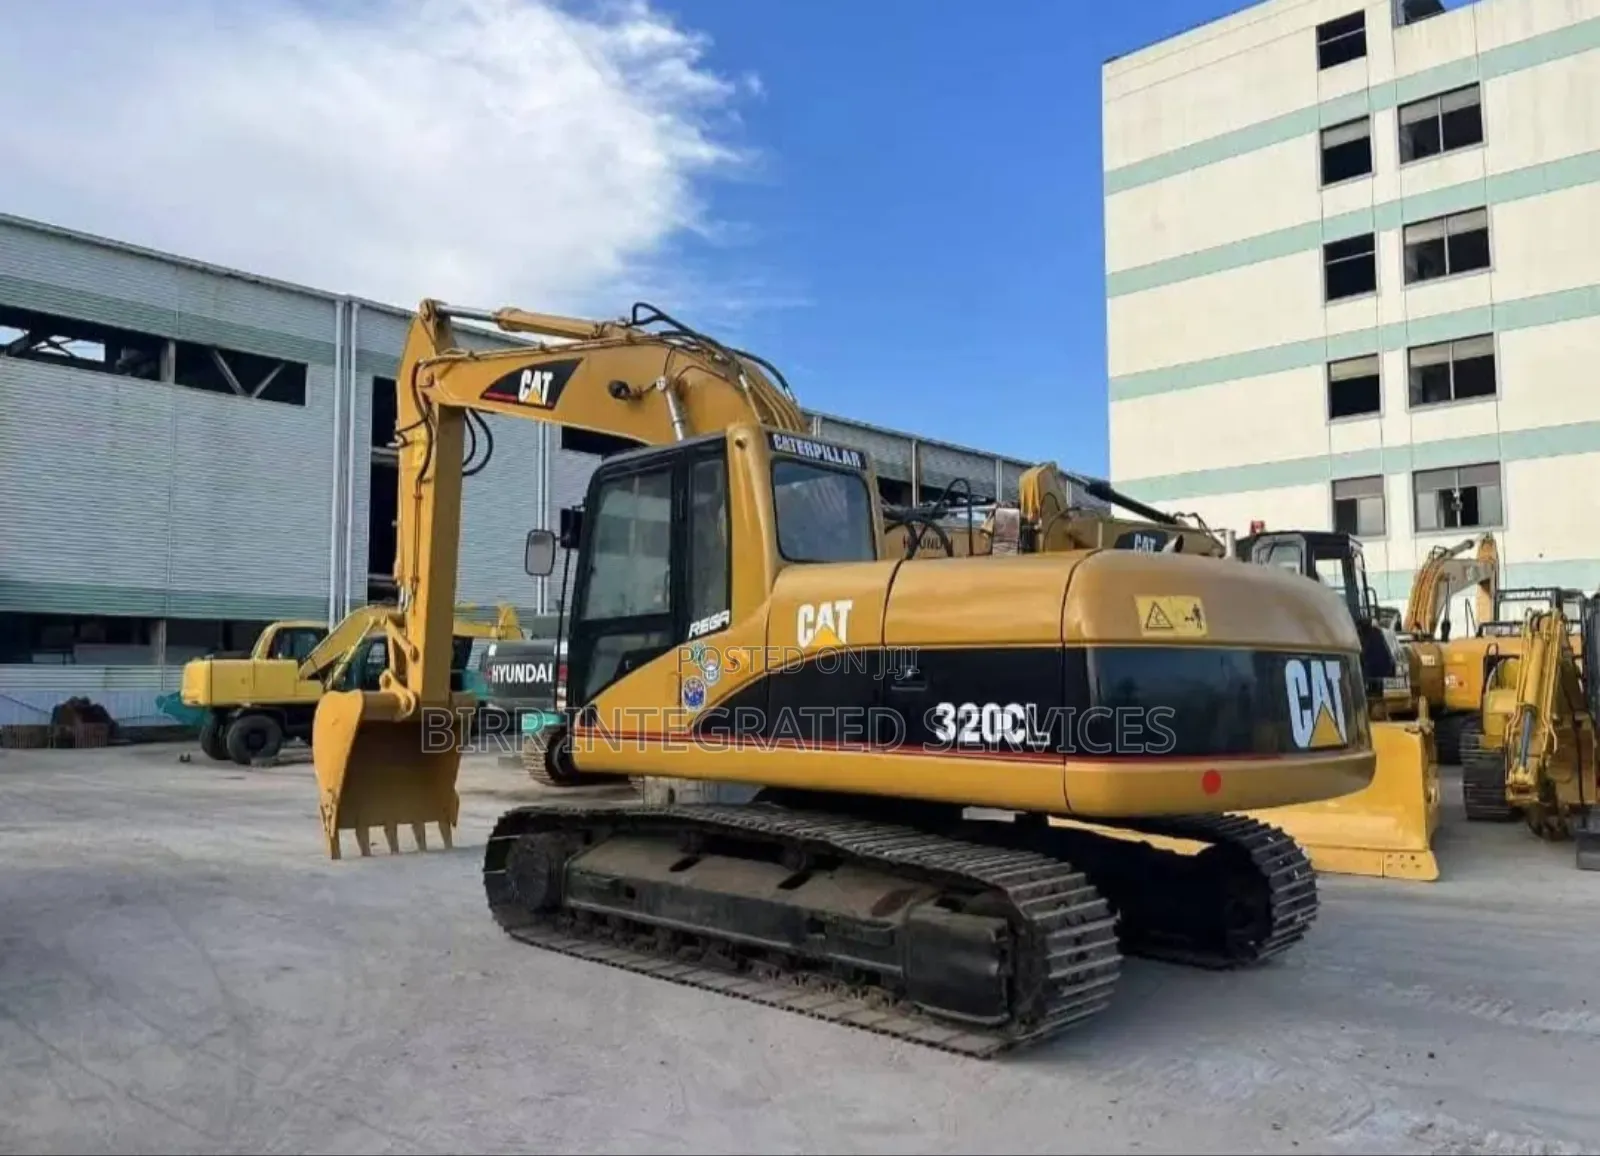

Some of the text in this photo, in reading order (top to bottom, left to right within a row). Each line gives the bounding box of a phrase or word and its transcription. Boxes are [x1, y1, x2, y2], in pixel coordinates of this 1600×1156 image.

[518, 369, 553, 406] CAT
[773, 433, 861, 468] CATERPILLAR
[797, 600, 852, 648] CAT
[491, 664, 553, 684] HYUNDAI
[935, 702, 1051, 745] 320CL
[1285, 659, 1348, 748] CAT
